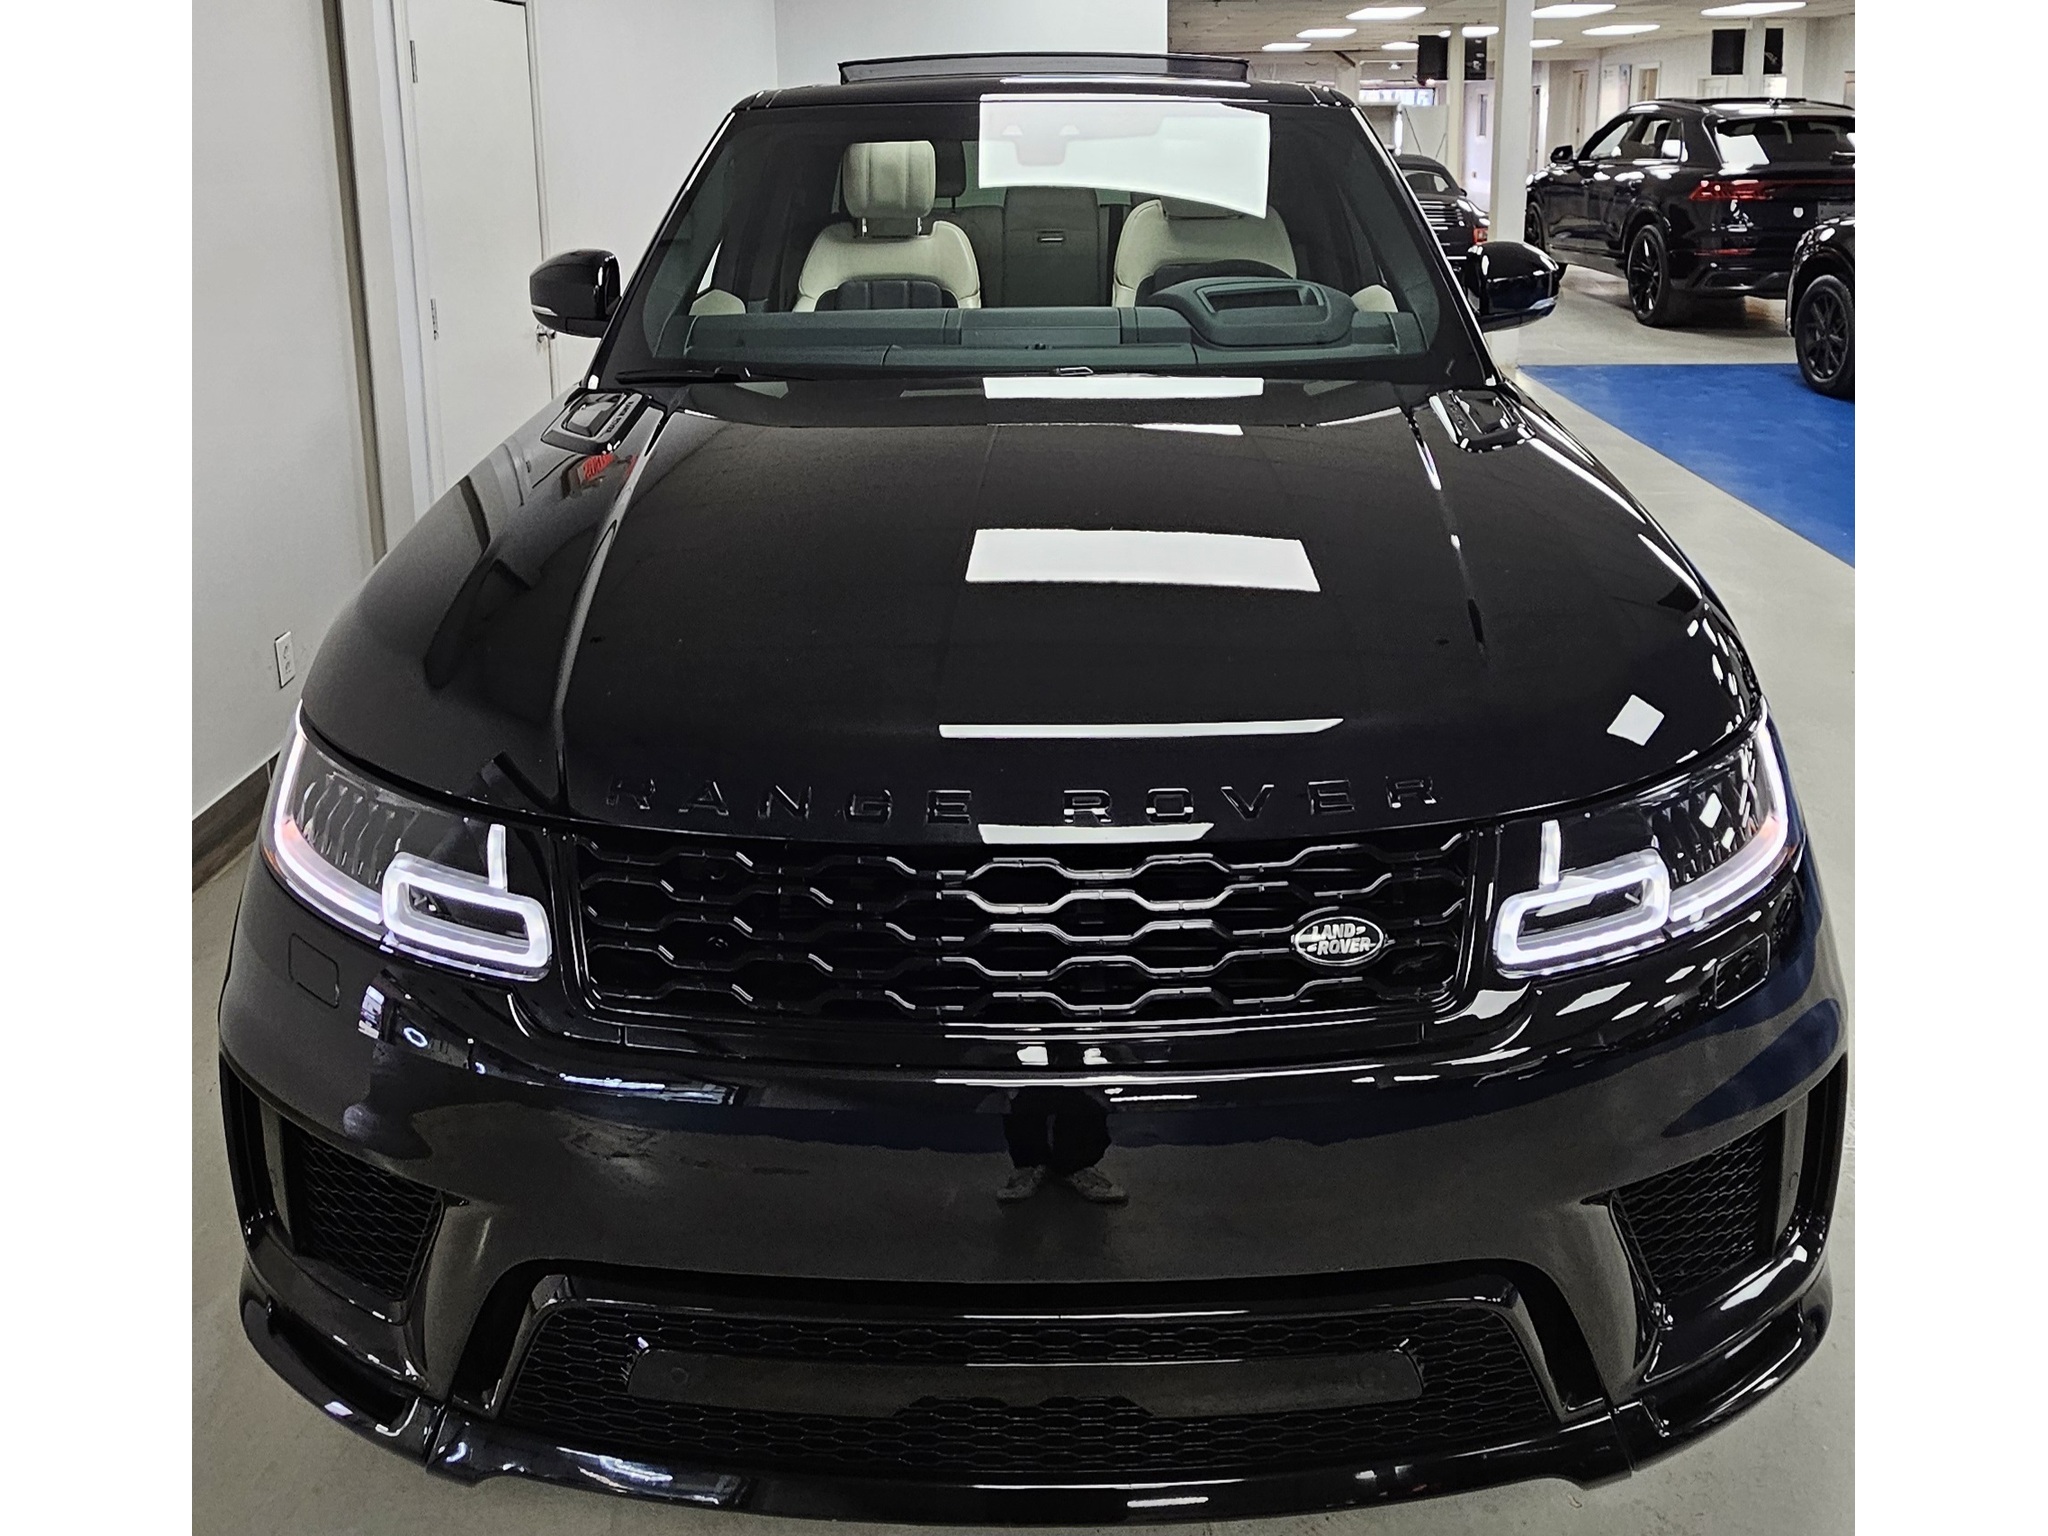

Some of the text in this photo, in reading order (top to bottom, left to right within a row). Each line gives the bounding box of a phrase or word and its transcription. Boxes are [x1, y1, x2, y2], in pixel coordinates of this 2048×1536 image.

[606, 775, 1439, 825] RANGE ROVER
[1311, 923, 1356, 940] LAND
[1316, 937, 1371, 956] ROVER
